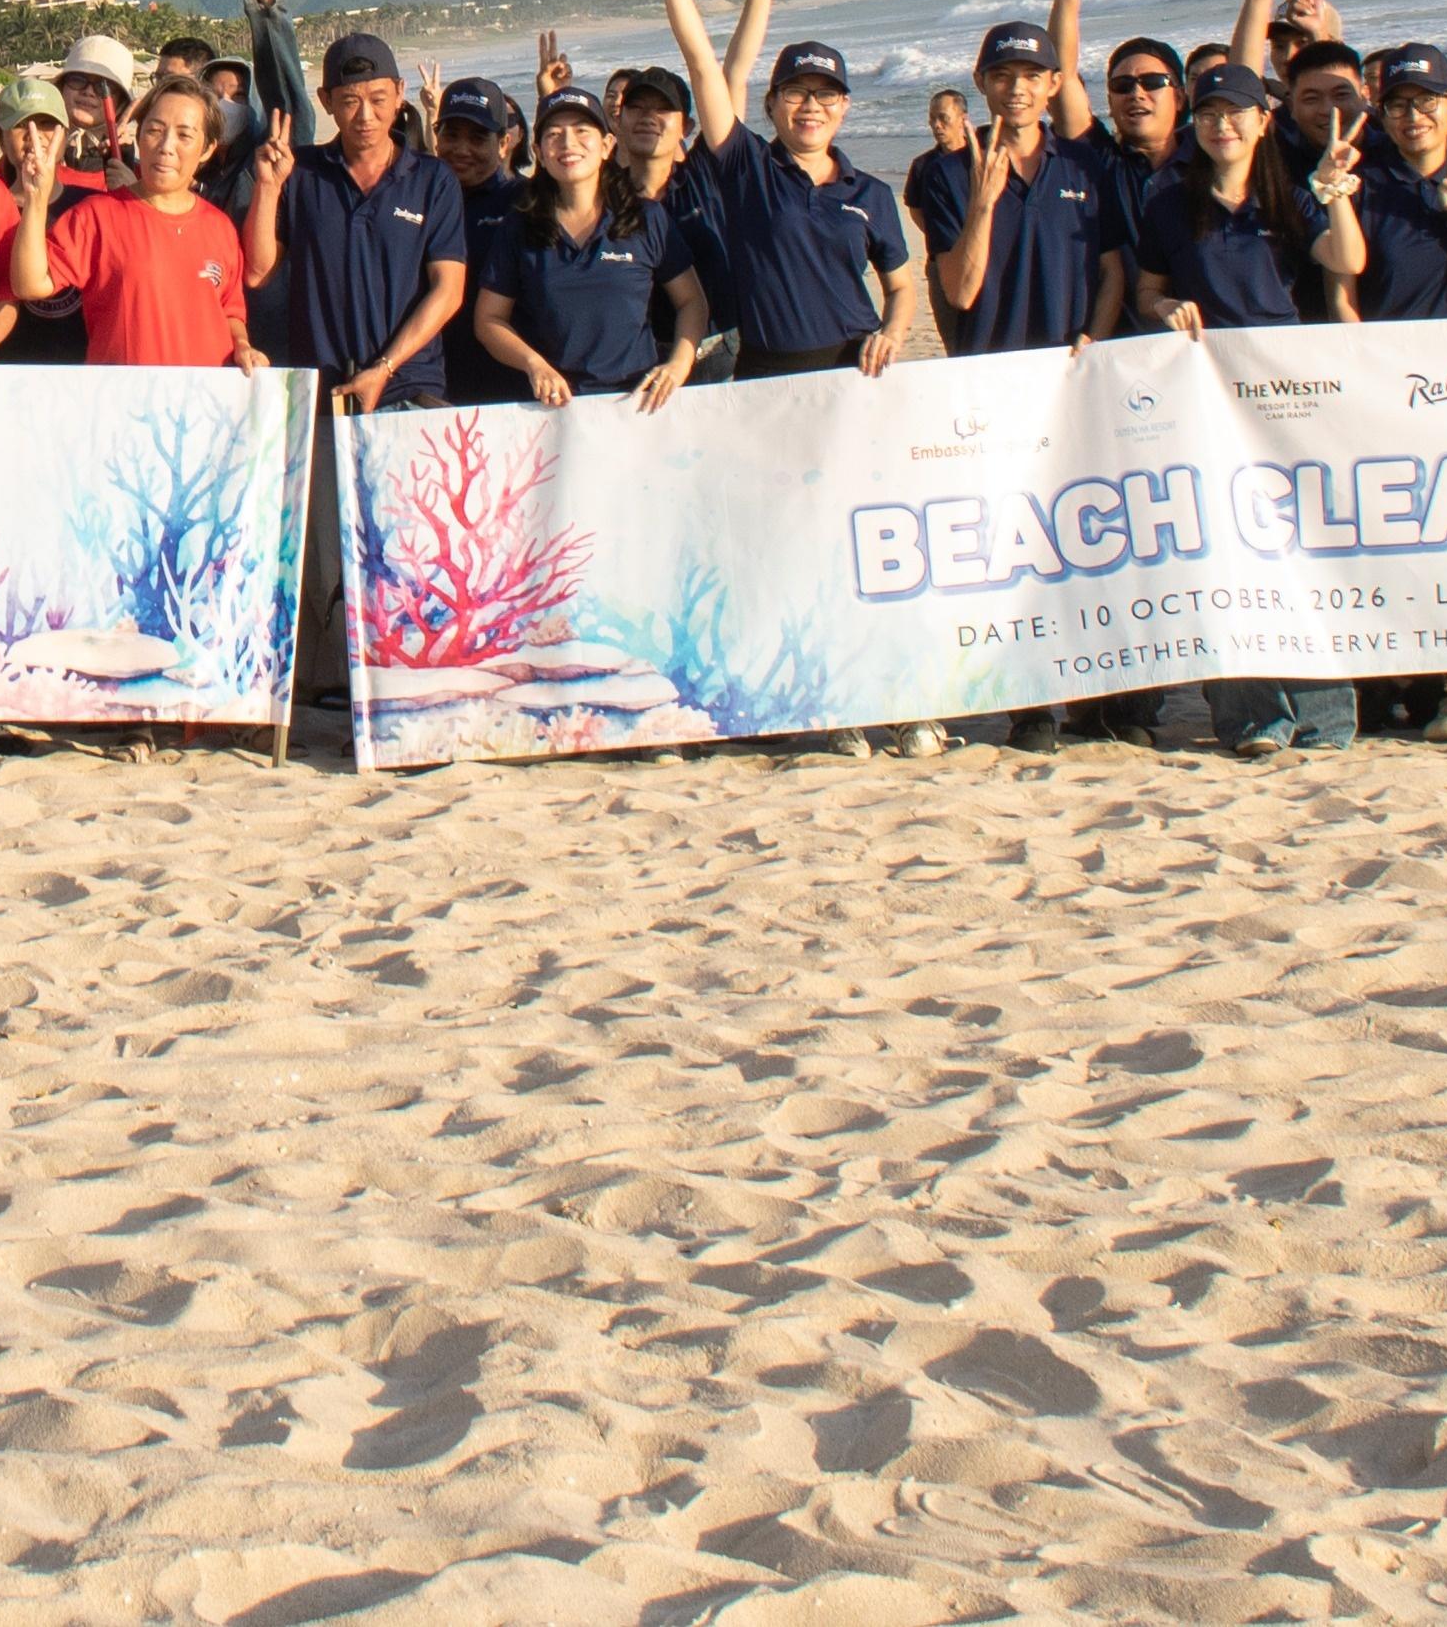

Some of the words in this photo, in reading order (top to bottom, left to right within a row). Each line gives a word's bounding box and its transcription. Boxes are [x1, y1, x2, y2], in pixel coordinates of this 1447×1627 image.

[1232, 381, 1269, 398] THE
[1270, 379, 1342, 396] WESTIN
[849, 464, 1209, 602] BEACH
[957, 616, 1059, 647] DATE:
[1079, 605, 1111, 630] 10
[1130, 588, 1293, 620] OCTOBER,
[1309, 585, 1386, 611] 2026
[1053, 636, 1218, 677] TOGETHER,
[1230, 633, 1266, 652] WE
[1278, 631, 1398, 654] PREERVE
